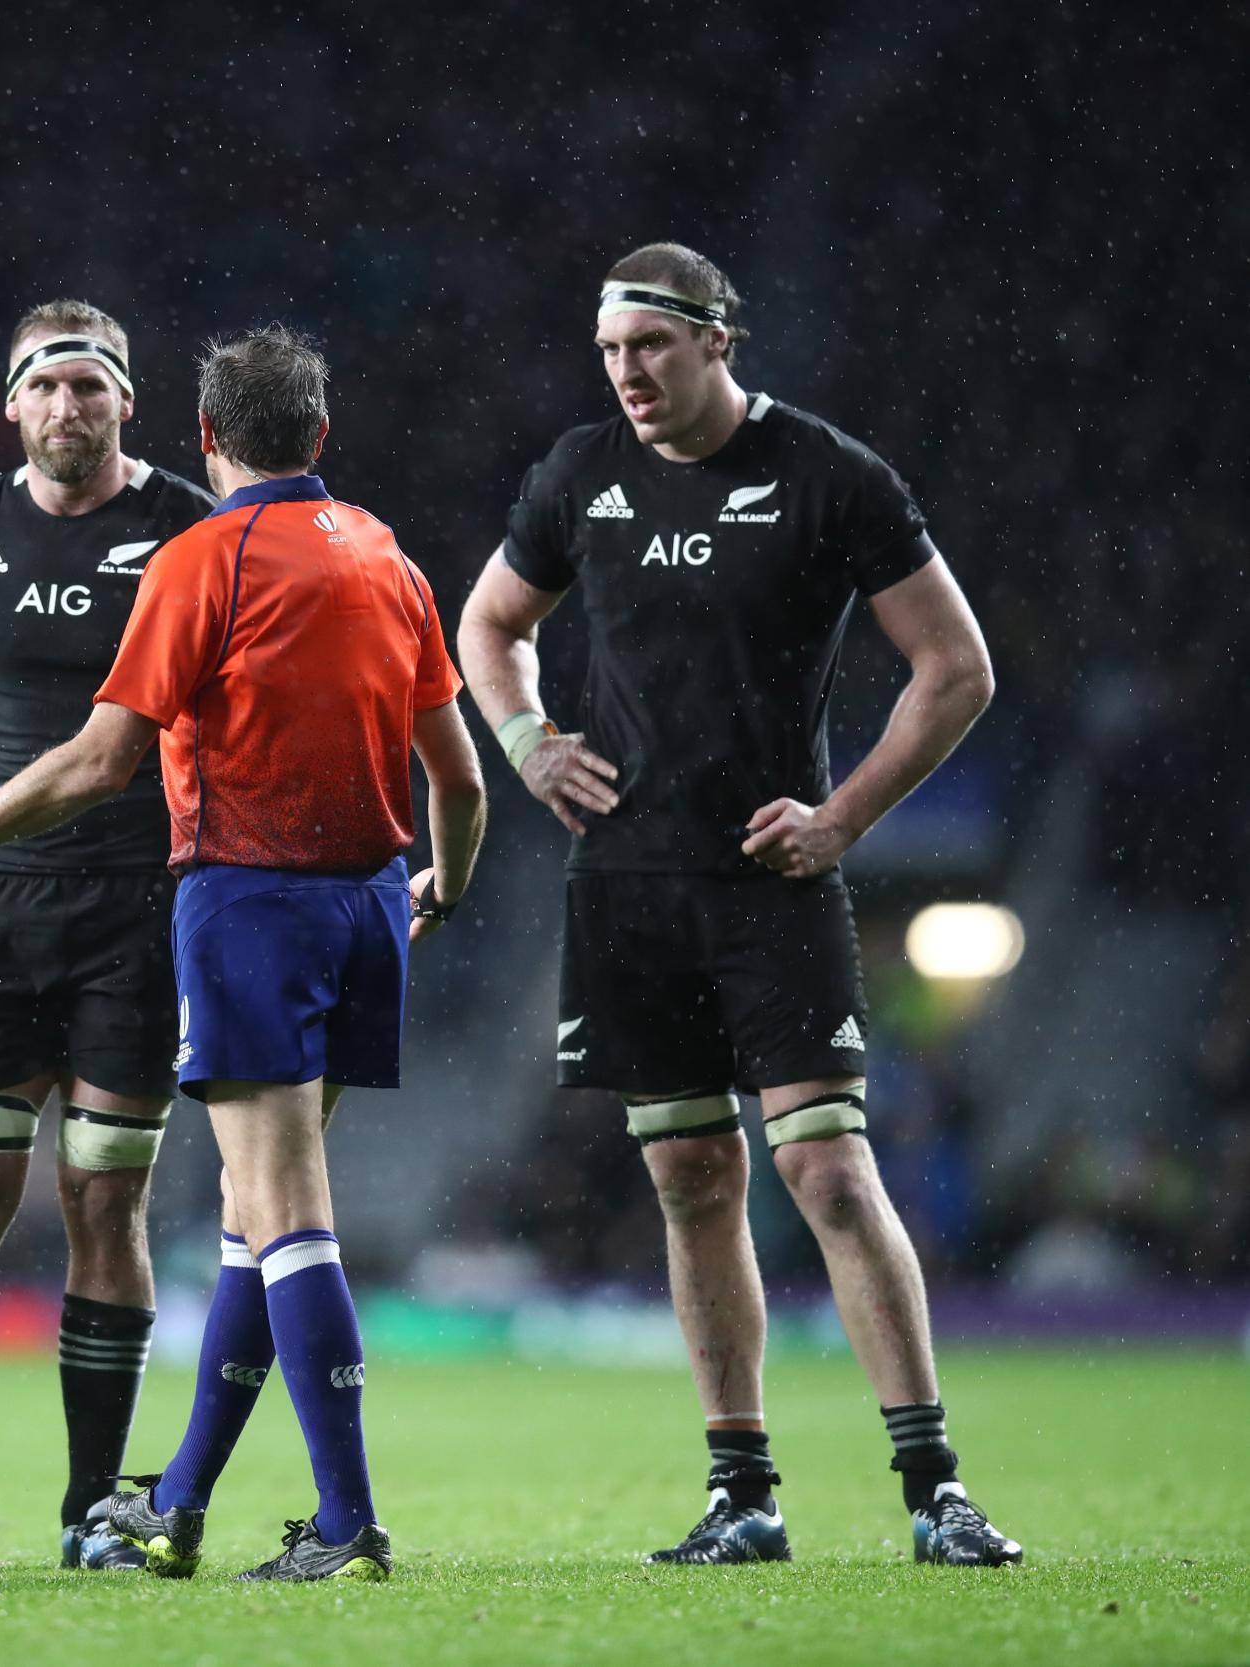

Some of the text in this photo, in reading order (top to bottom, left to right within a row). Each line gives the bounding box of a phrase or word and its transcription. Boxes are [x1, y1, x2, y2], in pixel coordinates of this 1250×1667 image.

[587, 504, 634, 519] adidas
[718, 513, 777, 523] ALL BLACKS
[641, 533, 712, 566] AIG
[15, 582, 92, 616] AIG
